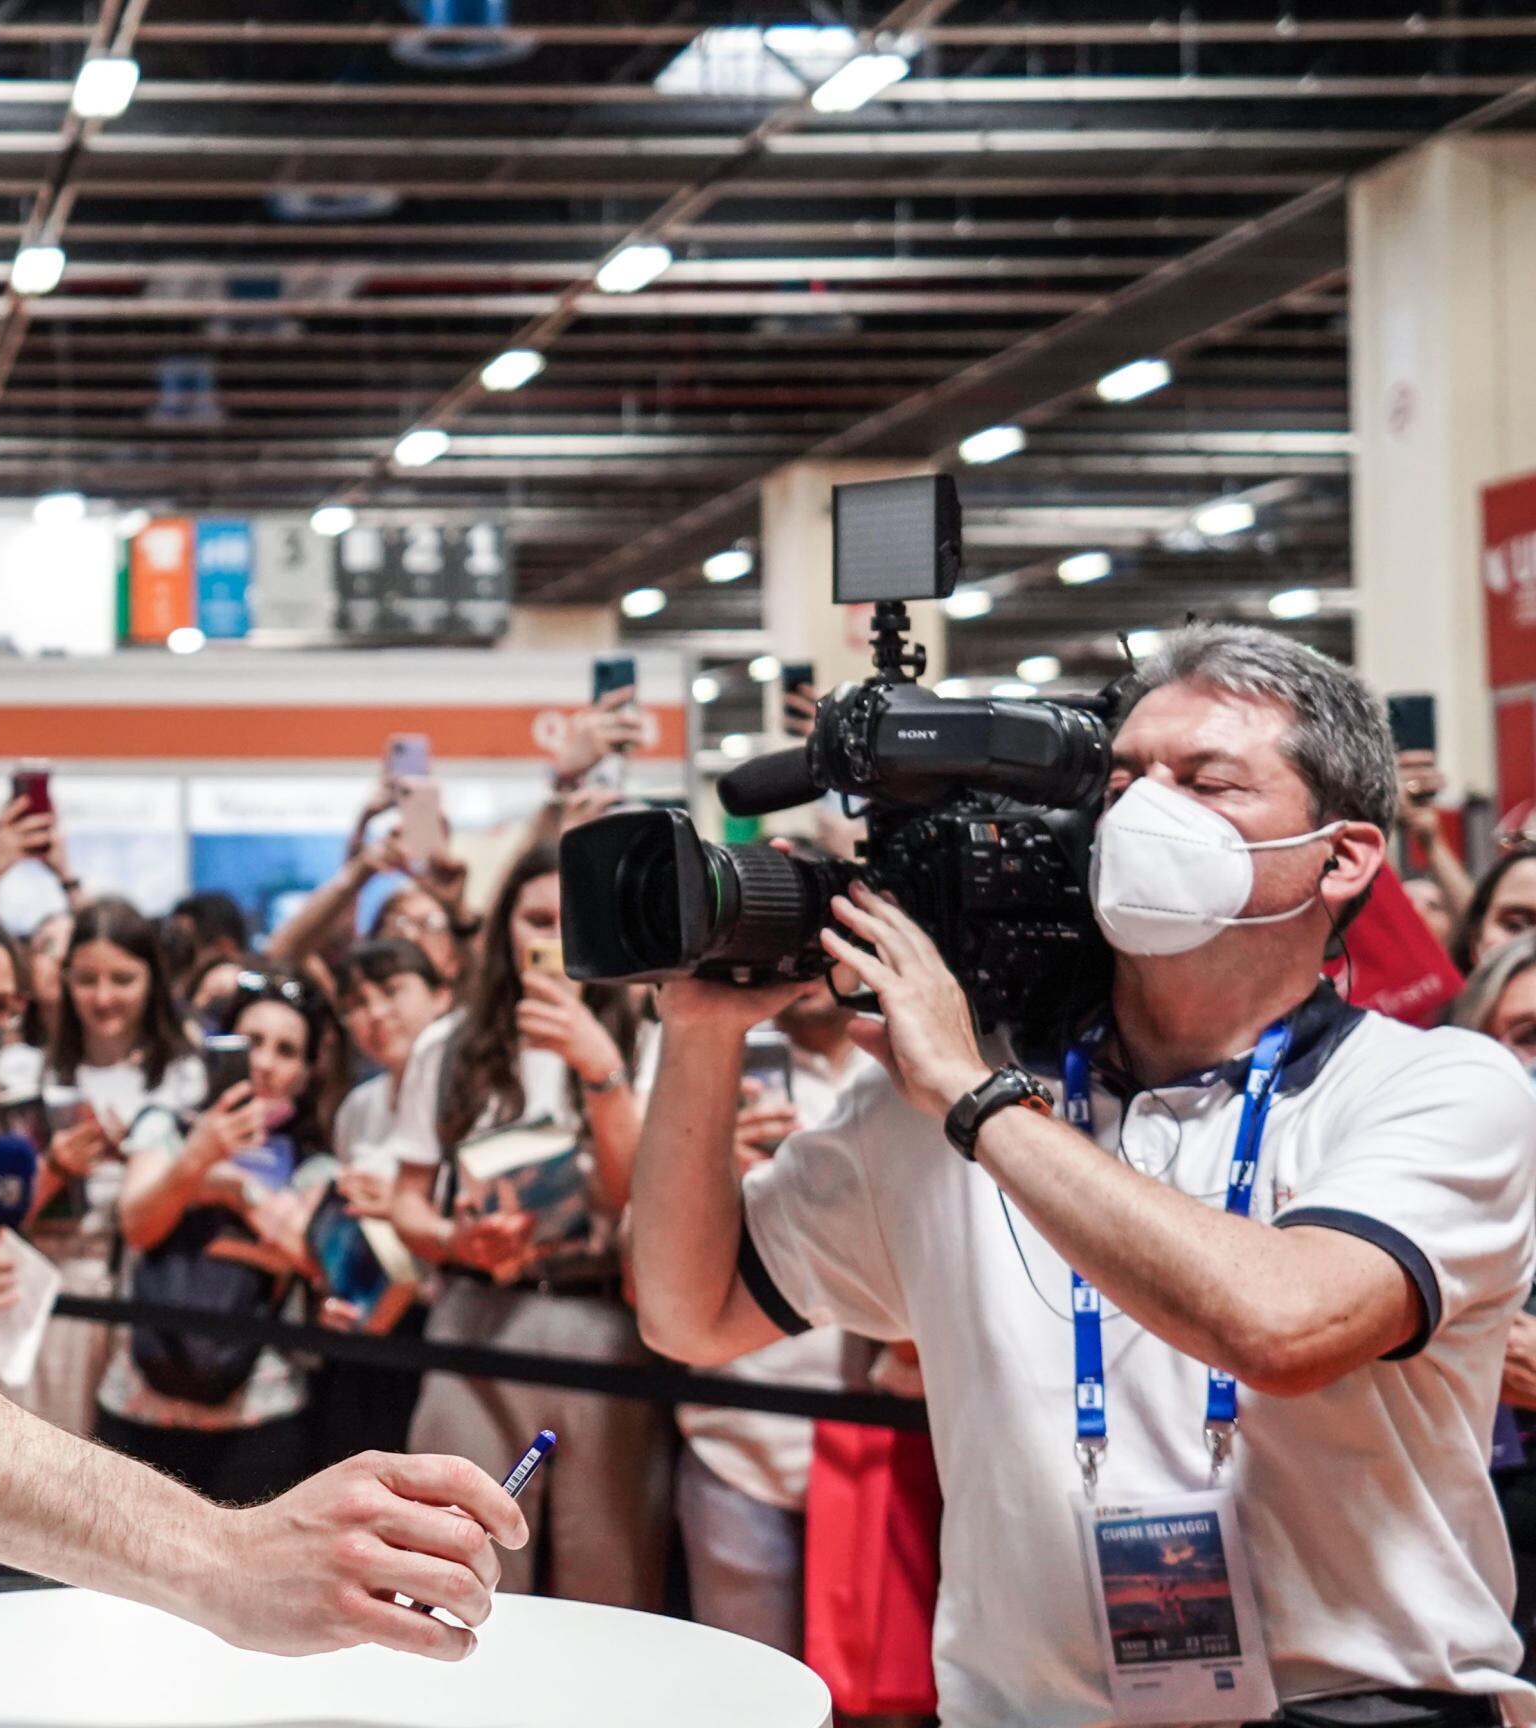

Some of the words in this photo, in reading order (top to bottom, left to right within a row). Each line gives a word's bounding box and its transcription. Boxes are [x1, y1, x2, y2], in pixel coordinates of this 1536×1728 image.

[897, 729, 938, 739] SONY
[1101, 1524, 1143, 1542] CUORI
[1146, 1519, 1211, 1540] SELVAGGI
